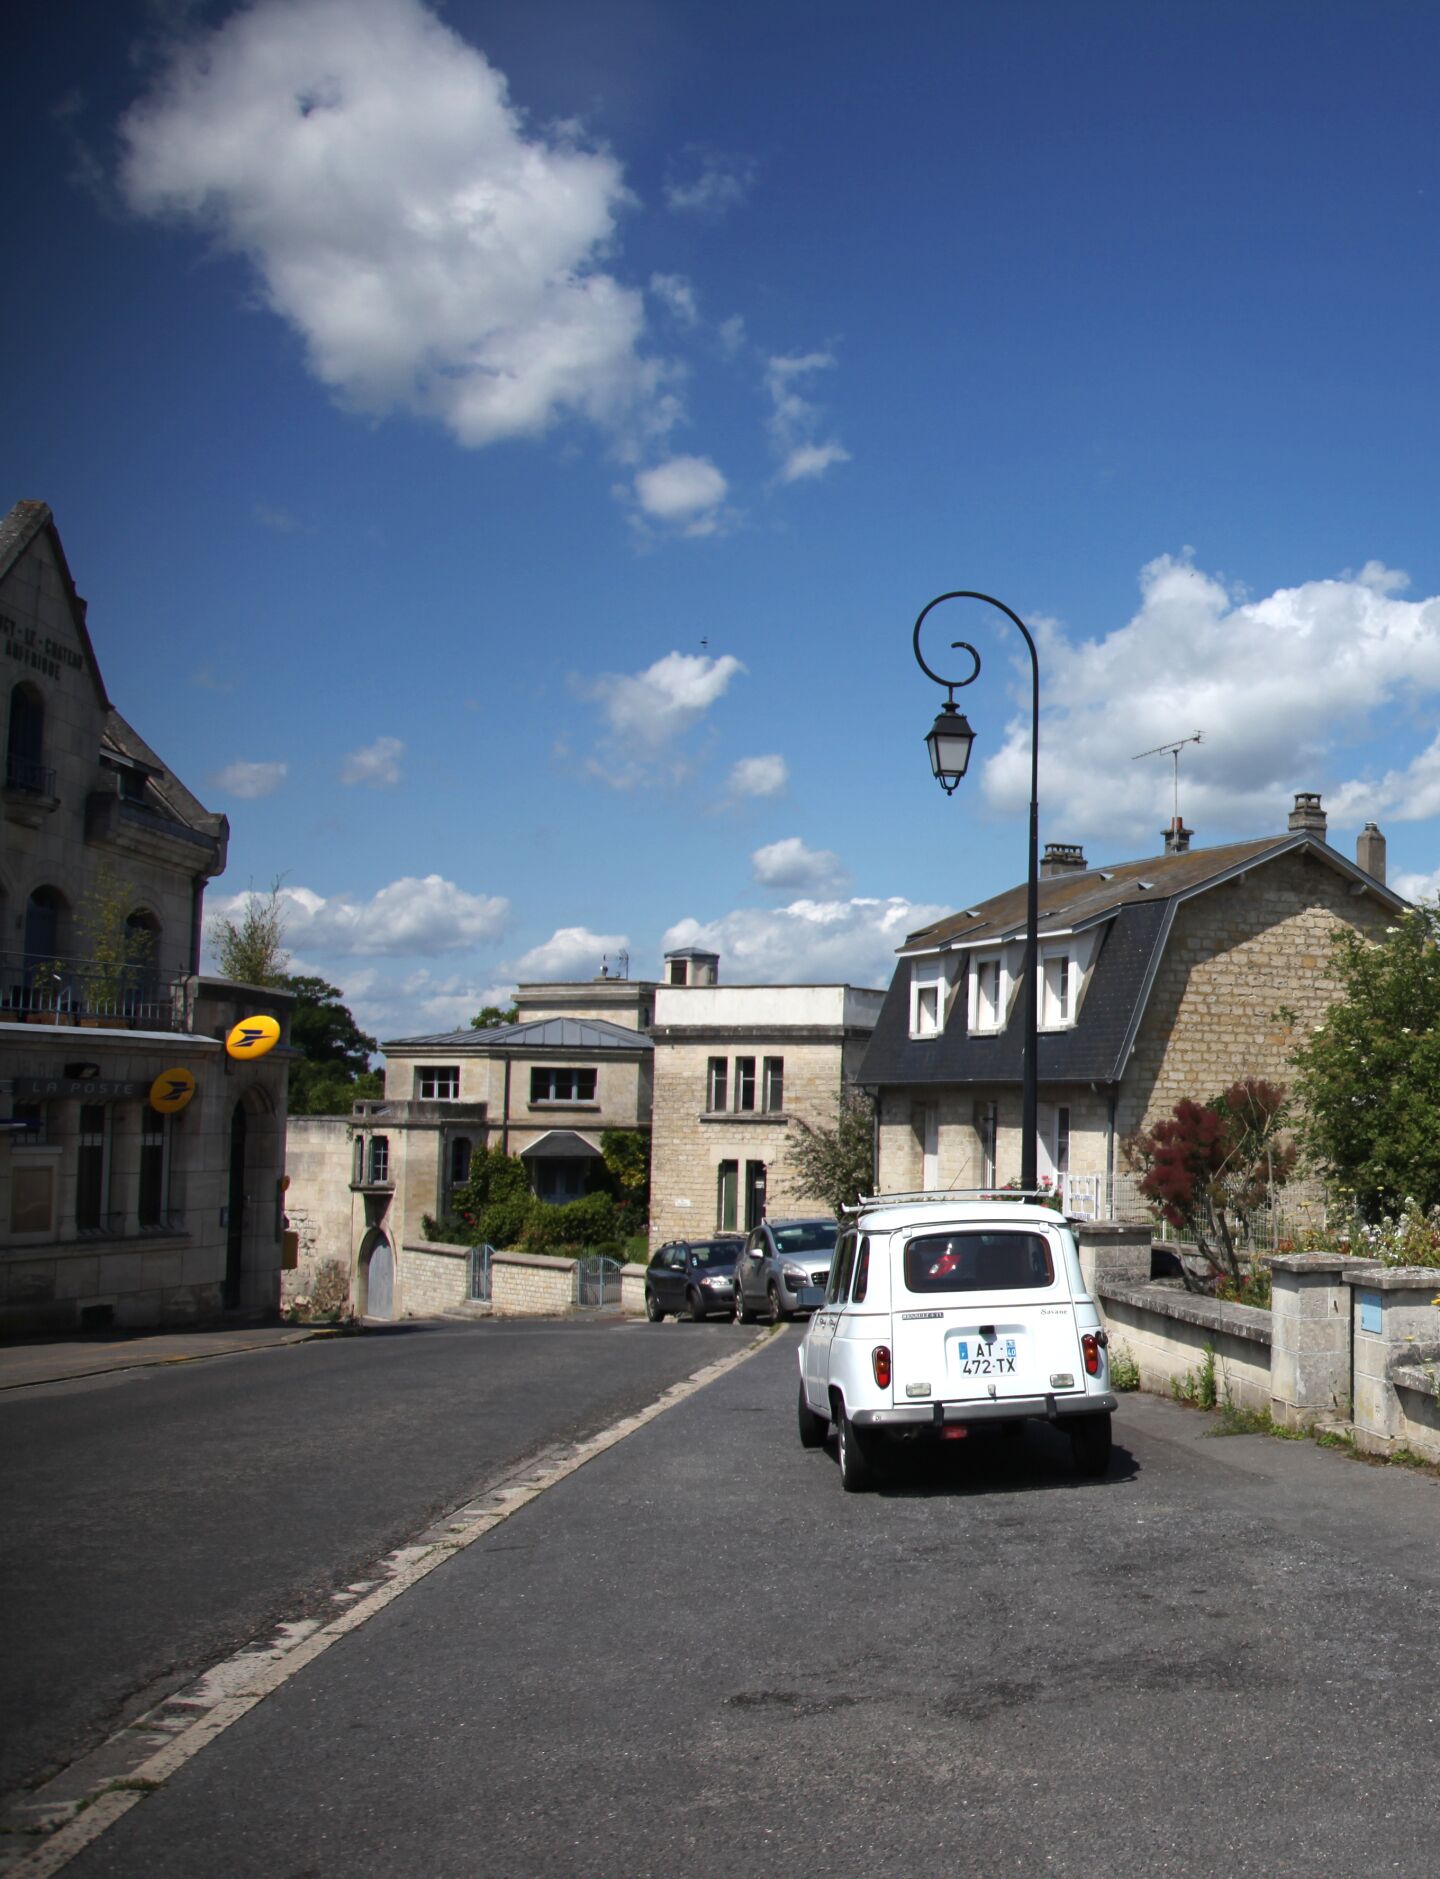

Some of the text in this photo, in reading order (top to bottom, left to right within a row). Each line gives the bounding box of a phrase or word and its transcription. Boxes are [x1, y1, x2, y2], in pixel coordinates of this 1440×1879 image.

[32, 1081, 134, 1095] LA POSTE
[1040, 1308, 1068, 1316] Savane
